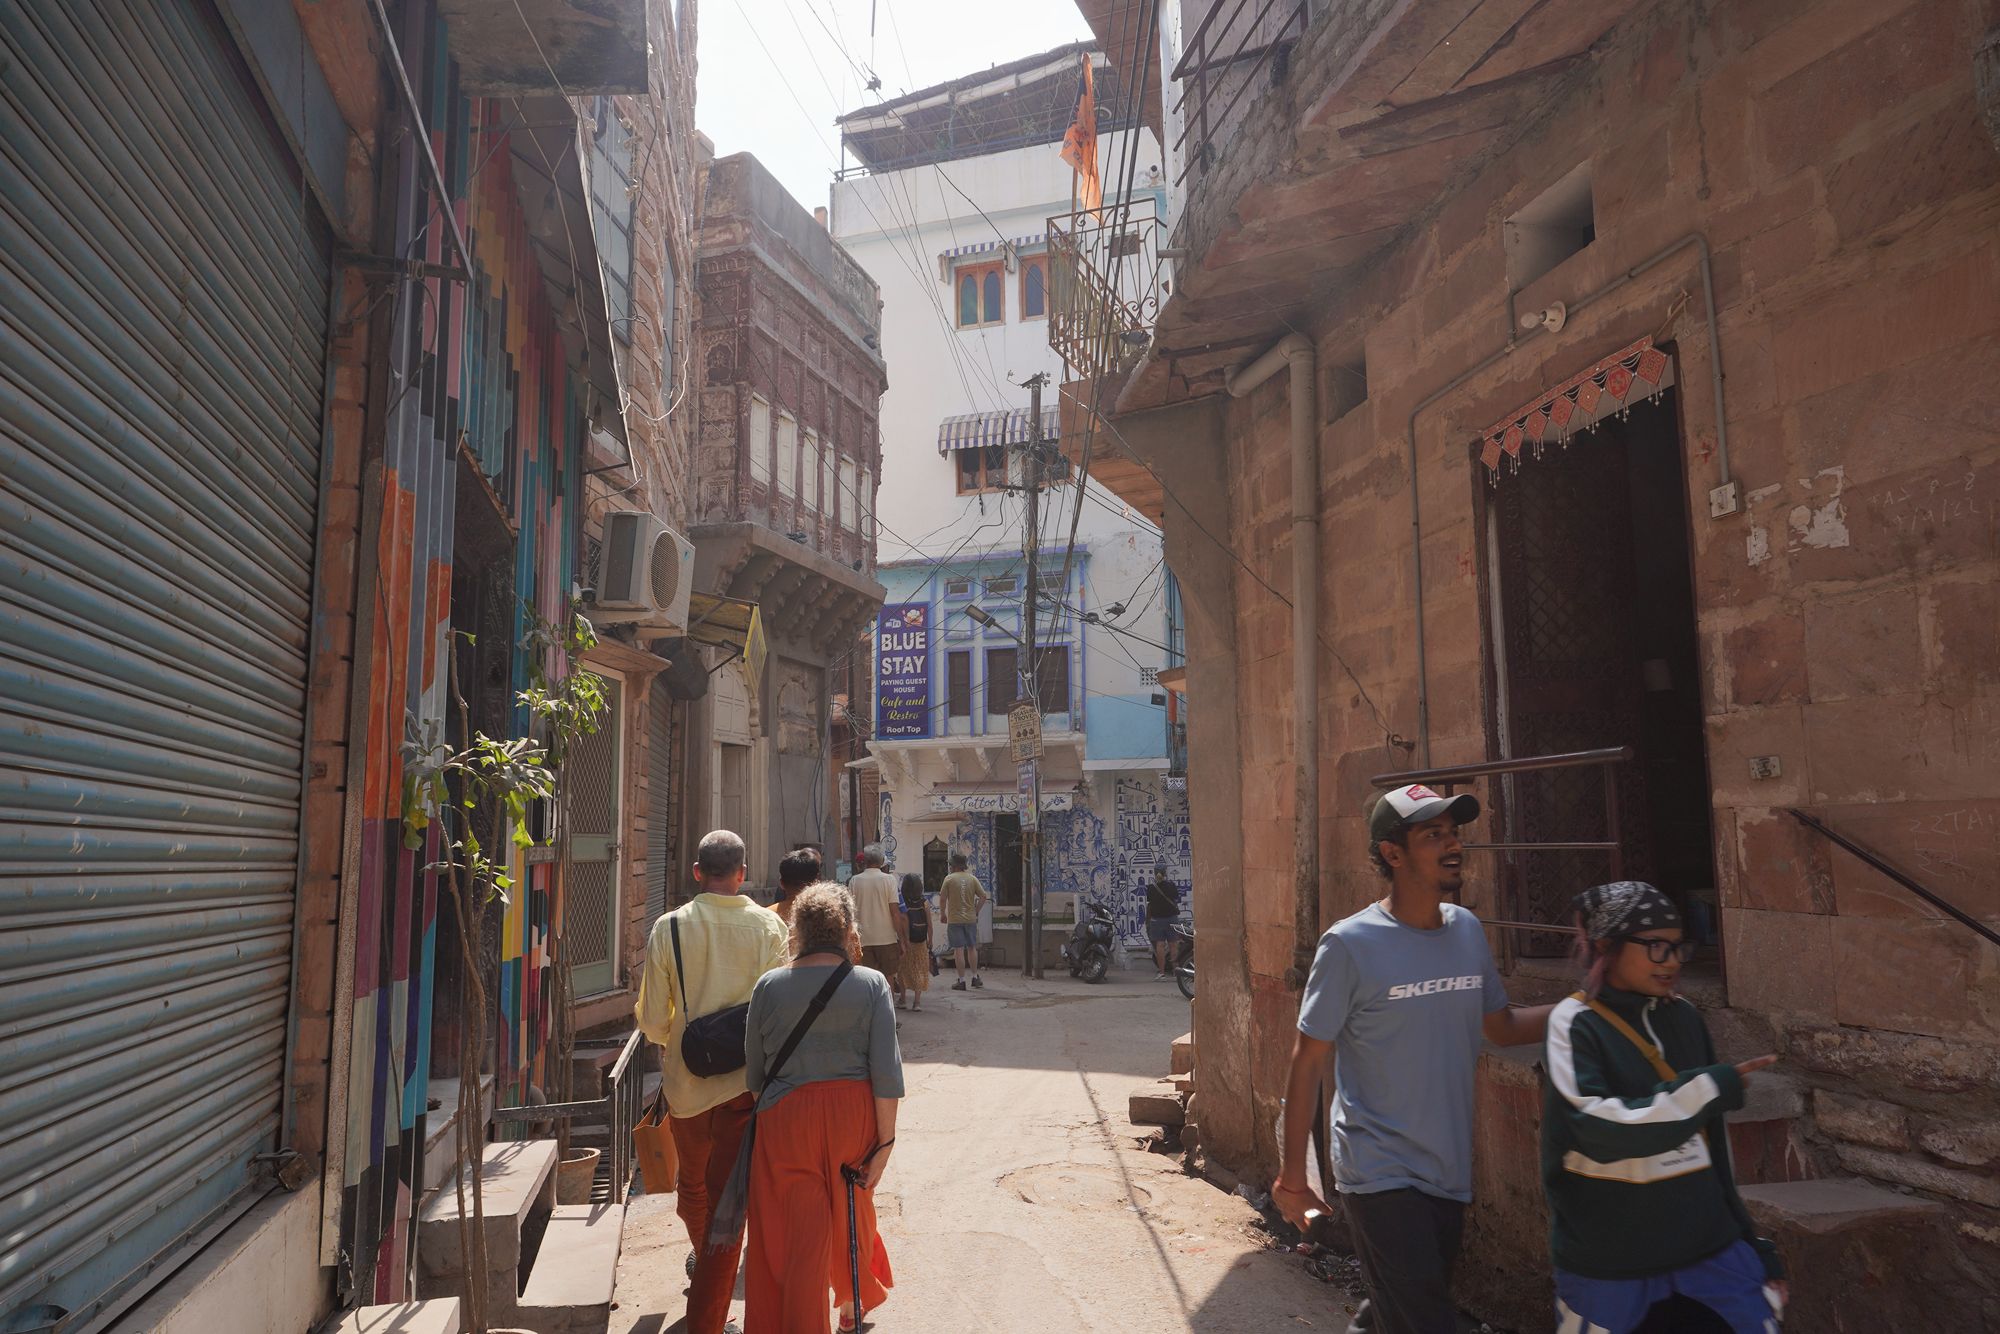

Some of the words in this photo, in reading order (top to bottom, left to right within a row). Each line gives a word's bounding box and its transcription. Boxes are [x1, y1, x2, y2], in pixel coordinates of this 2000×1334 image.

[881, 631, 926, 651] BLUE
[881, 656, 925, 675] STAY
[881, 678, 904, 686] PAYING
[880, 696, 902, 708] Cafe
[905, 695, 925, 706] and
[886, 710, 919, 721] Restro
[886, 726, 904, 734] Roof
[906, 725, 921, 734] Top
[958, 796, 997, 811] Tattoo
